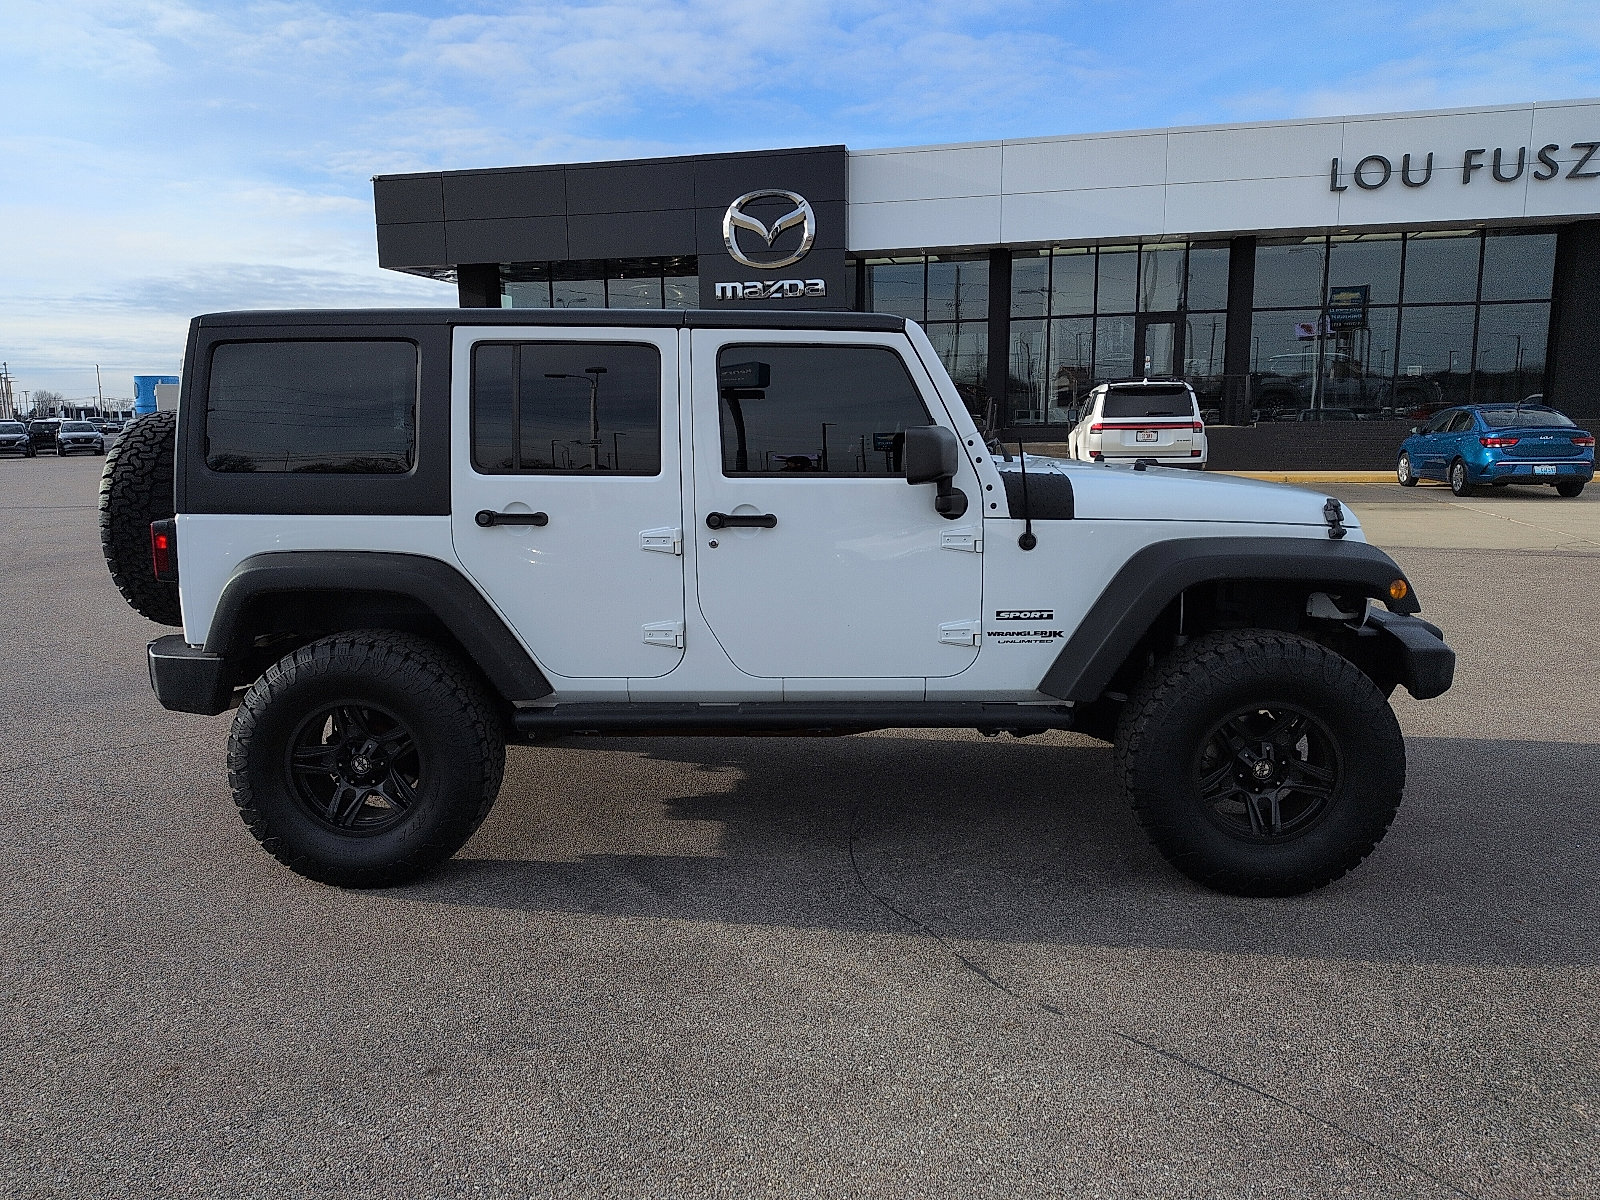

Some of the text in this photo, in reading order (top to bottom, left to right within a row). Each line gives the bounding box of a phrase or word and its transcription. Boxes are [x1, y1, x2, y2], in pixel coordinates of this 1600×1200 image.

[1330, 141, 1600, 192] LOU FUSZ
[998, 611, 1053, 619] SPORT
